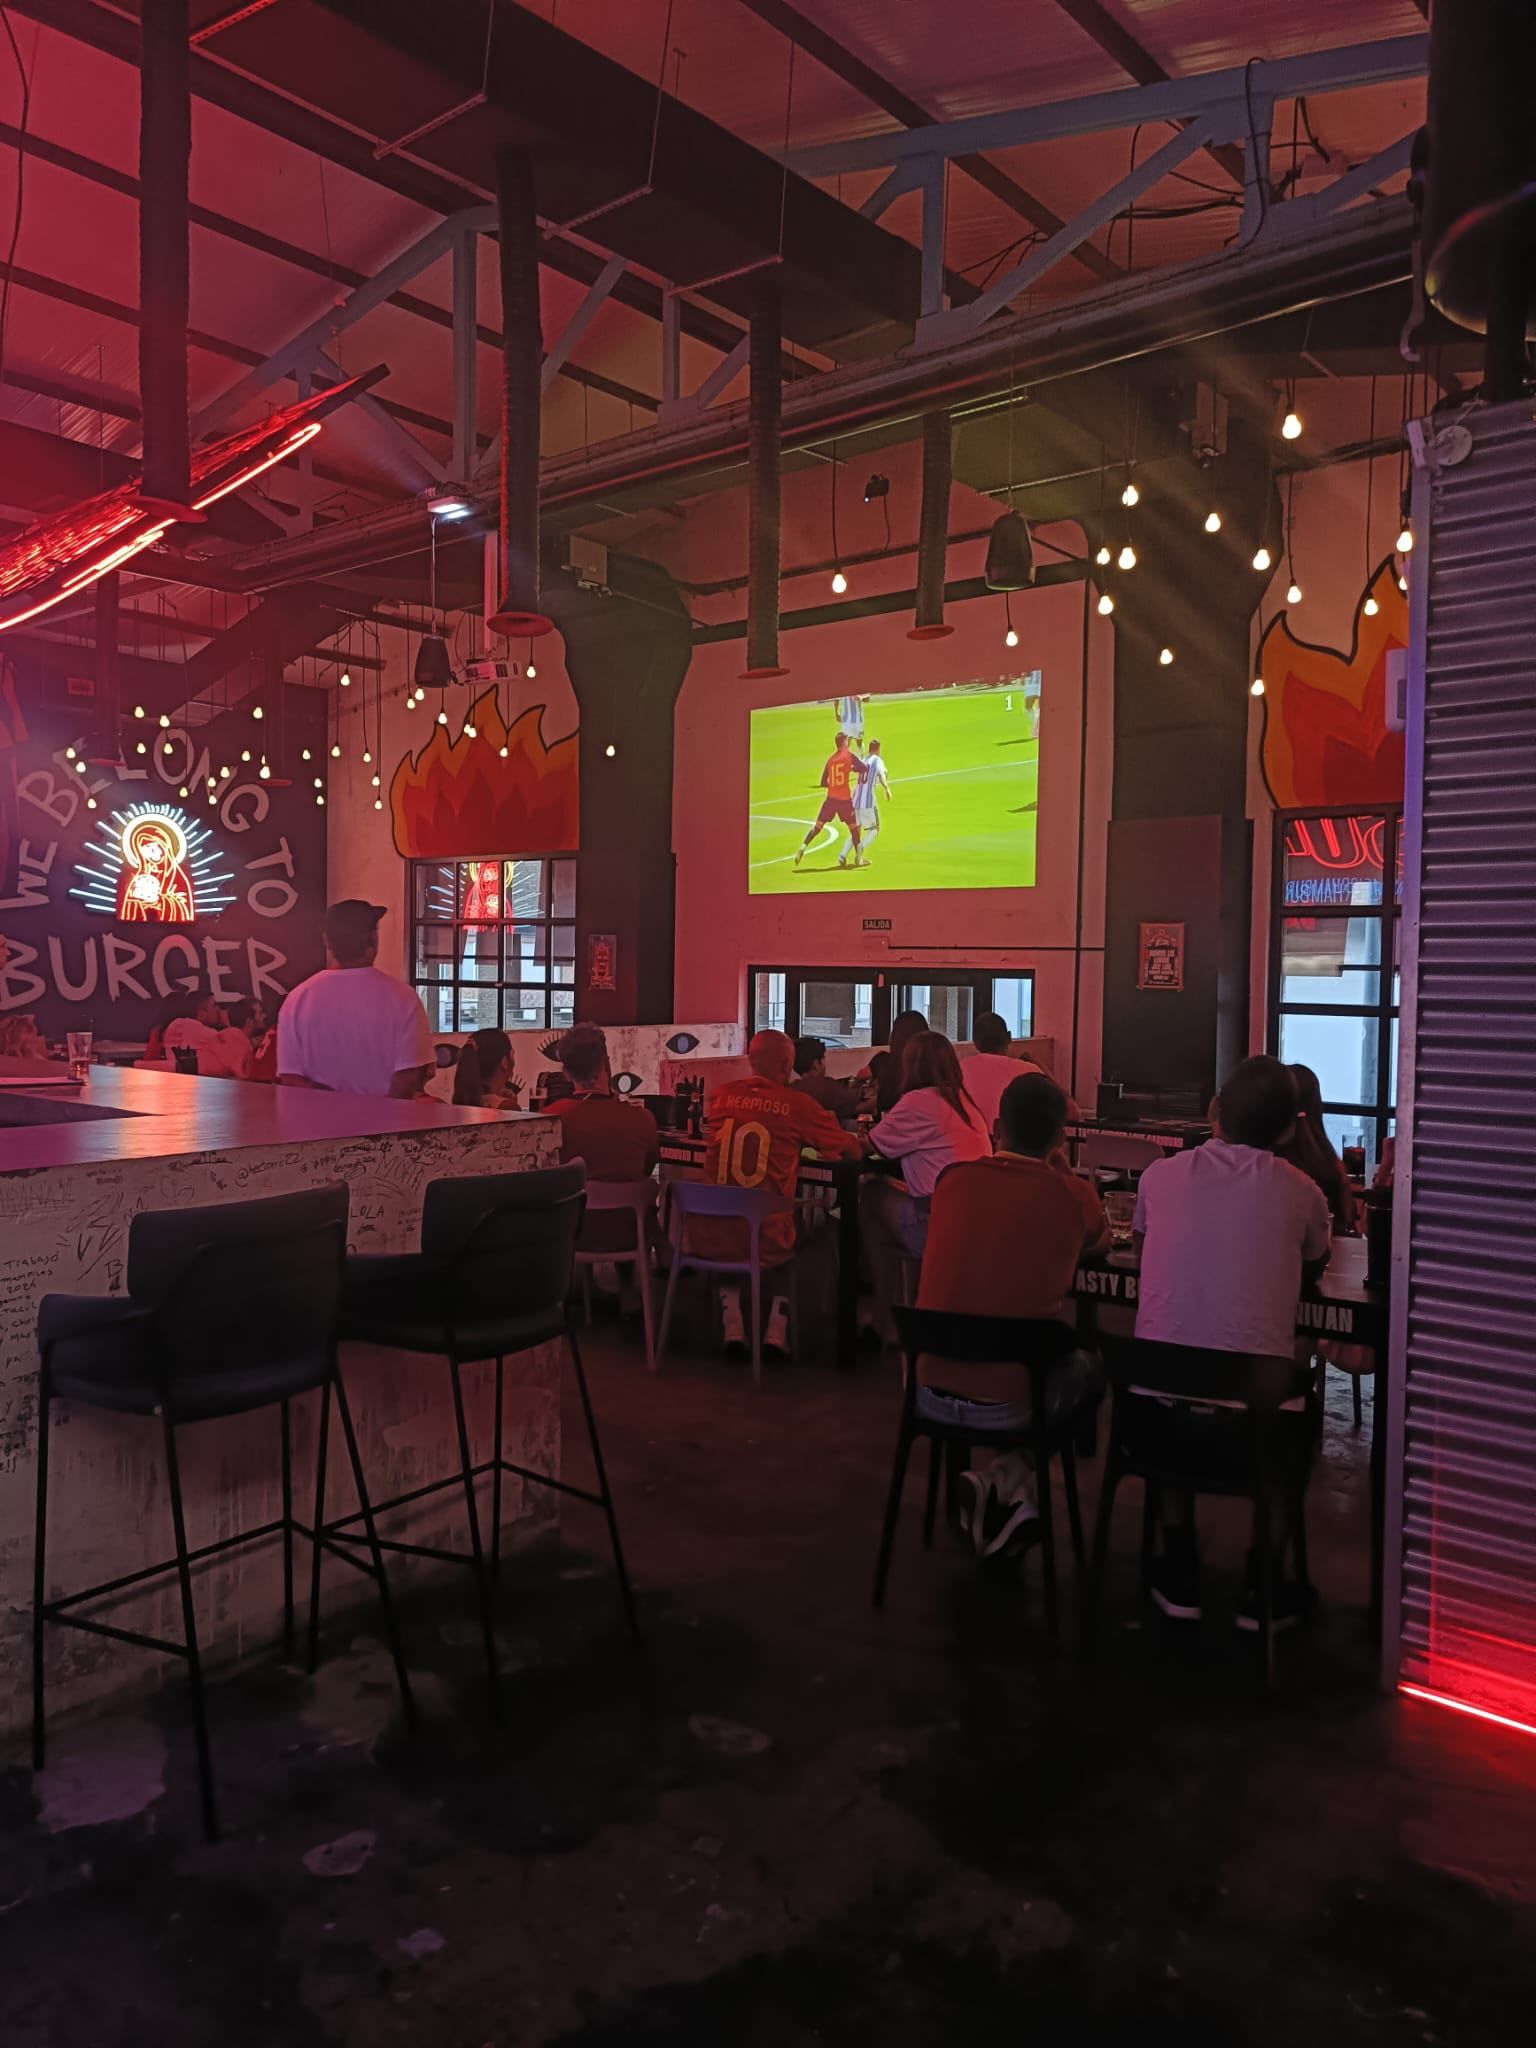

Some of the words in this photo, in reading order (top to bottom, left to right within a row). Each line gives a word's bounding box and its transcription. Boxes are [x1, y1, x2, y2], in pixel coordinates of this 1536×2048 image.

[1005, 695, 1013, 711] 1
[831, 763, 845, 787] 15
[18, 728, 270, 833] BELONG
[244, 836, 299, 918] TO
[864, 920, 890, 929] SALIDA
[0, 932, 289, 1011] BURGER
[726, 1095, 791, 1116] HERMOSO
[714, 1117, 772, 1188] 10
[1075, 1267, 1120, 1297] ASTY
[1296, 1301, 1353, 1334] NIVAN
